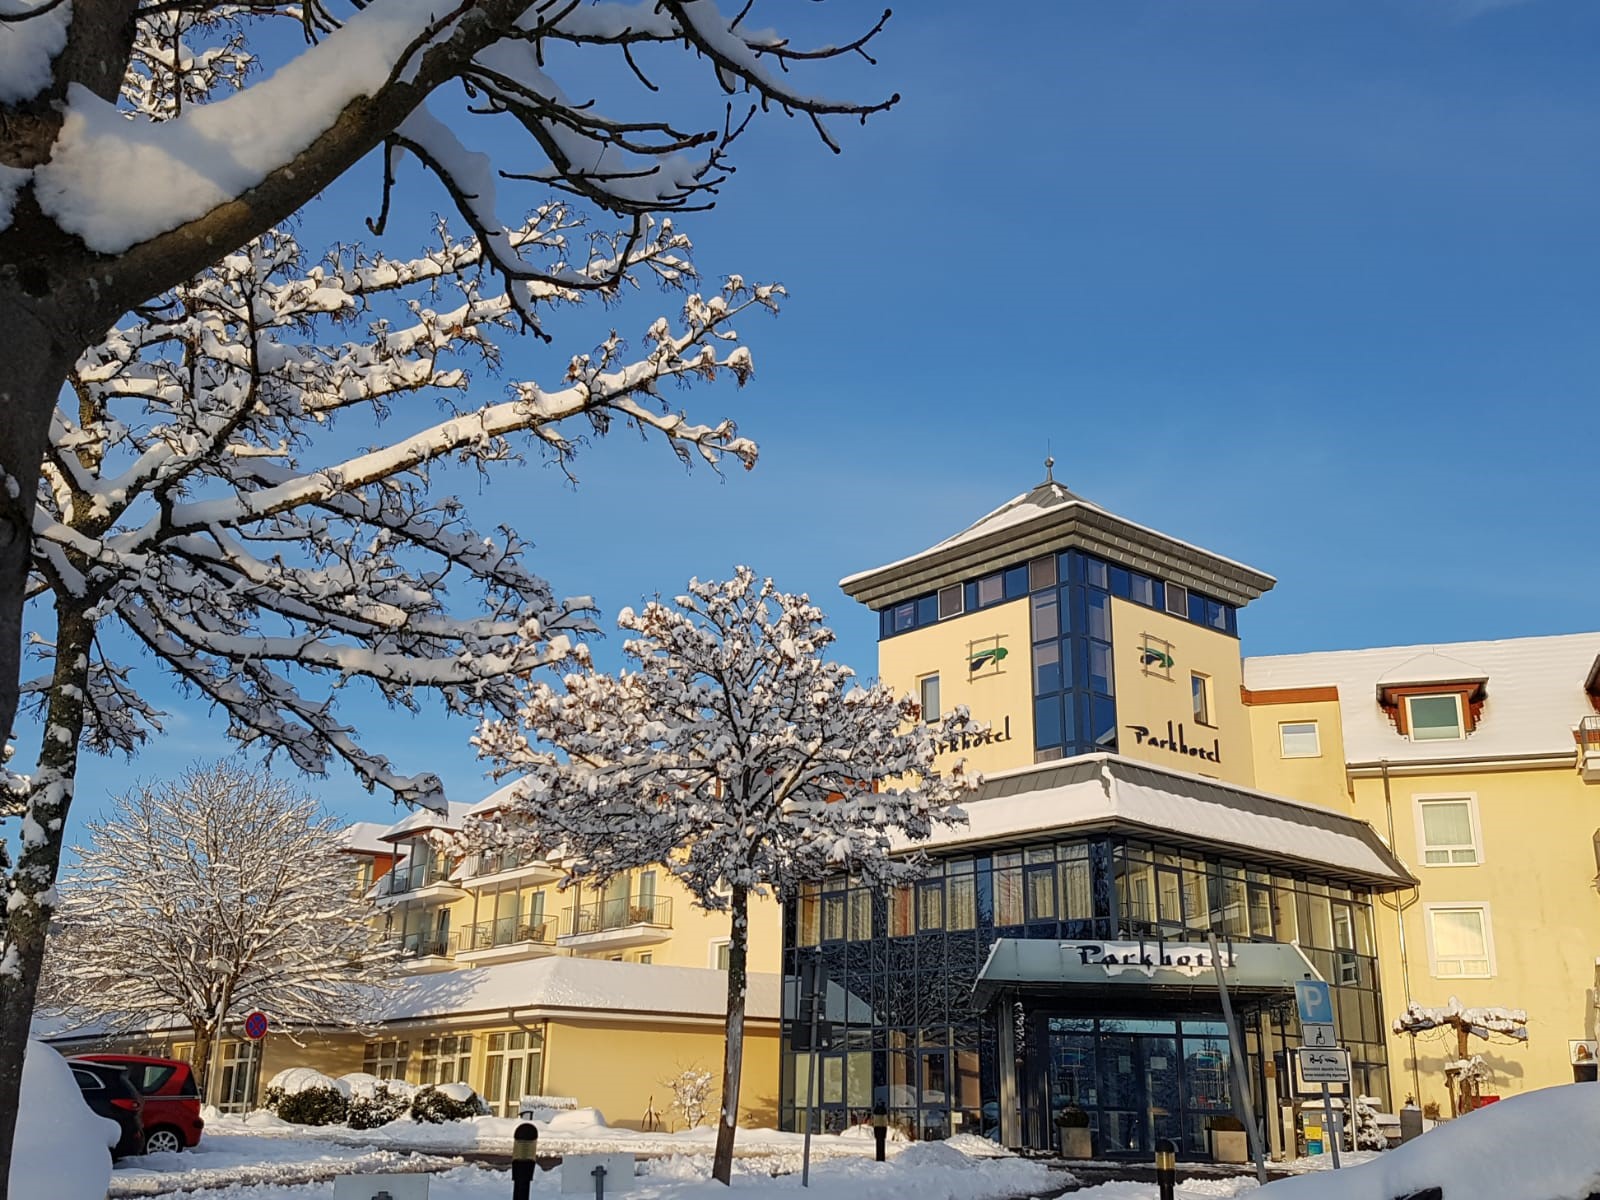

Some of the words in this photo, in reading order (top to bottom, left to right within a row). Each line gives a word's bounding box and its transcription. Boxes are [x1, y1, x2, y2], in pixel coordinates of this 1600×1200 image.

[930, 715, 1012, 756] rkhotel
[1125, 720, 1221, 763] Parkhotel
[1304, 986, 1322, 1017] P
